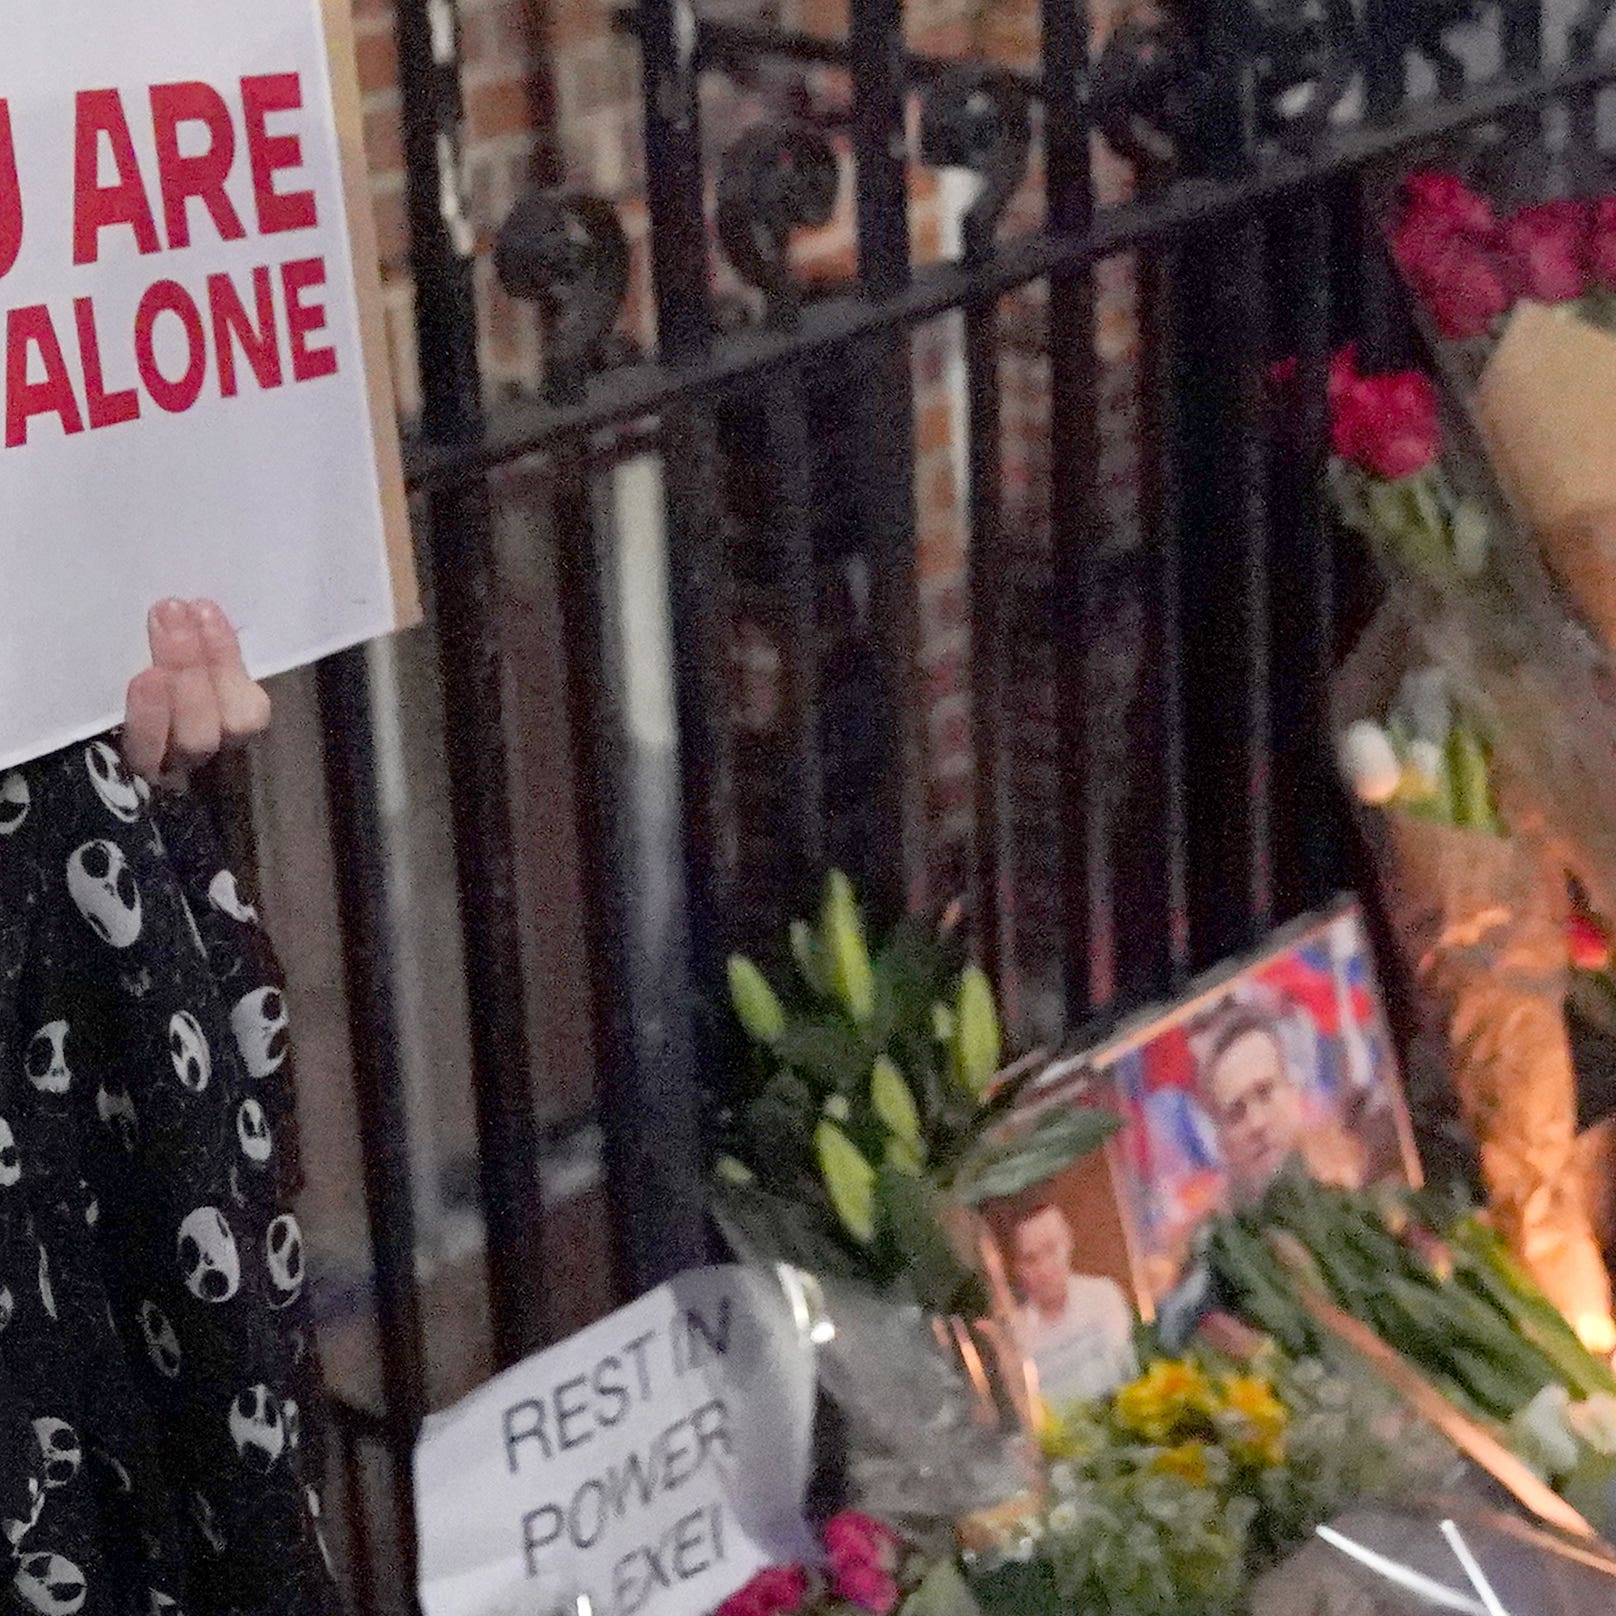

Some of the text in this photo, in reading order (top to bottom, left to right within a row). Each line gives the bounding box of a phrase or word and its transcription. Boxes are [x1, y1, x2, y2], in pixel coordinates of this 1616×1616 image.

[72, 71, 318, 266] ARE
[4, 257, 338, 448] ALONE
[501, 1295, 732, 1474] REST IN
[521, 1397, 734, 1579] POWER
